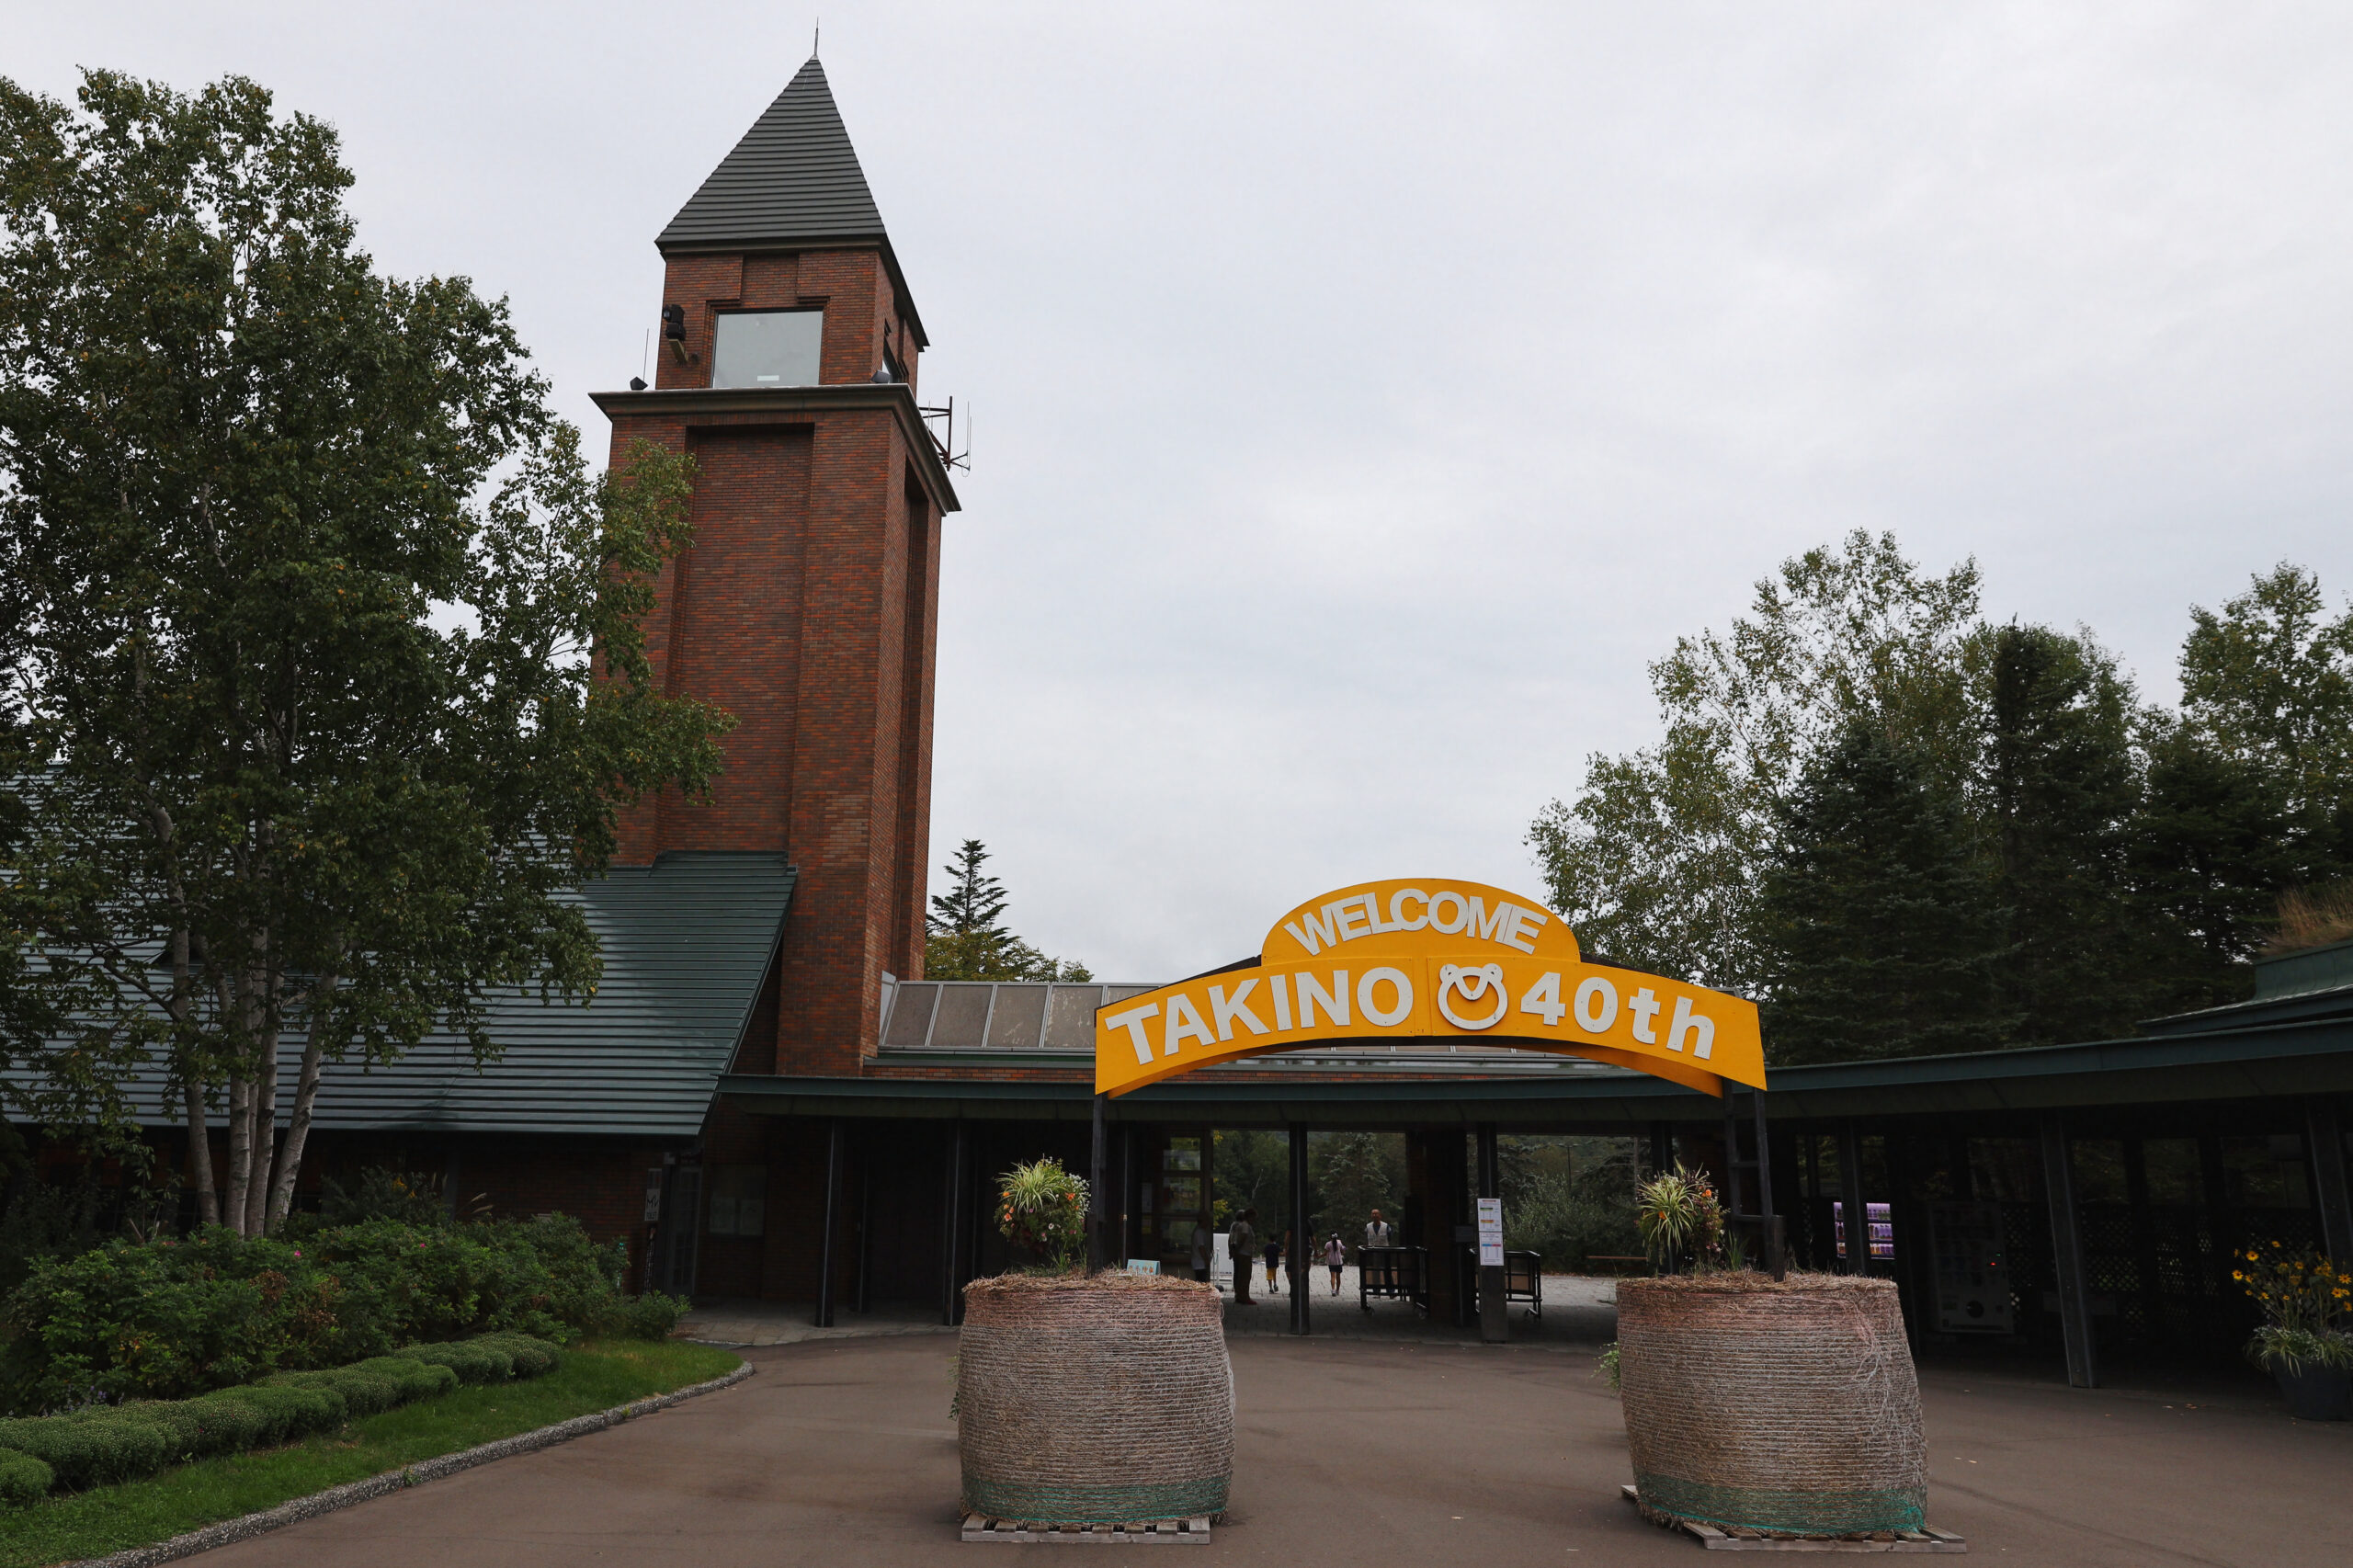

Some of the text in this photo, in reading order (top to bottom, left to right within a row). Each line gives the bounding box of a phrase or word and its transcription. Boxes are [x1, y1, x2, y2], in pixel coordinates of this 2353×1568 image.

[1283, 888, 1549, 956] WELCOME
[1104, 966, 1716, 1066] TAKINO 40th
